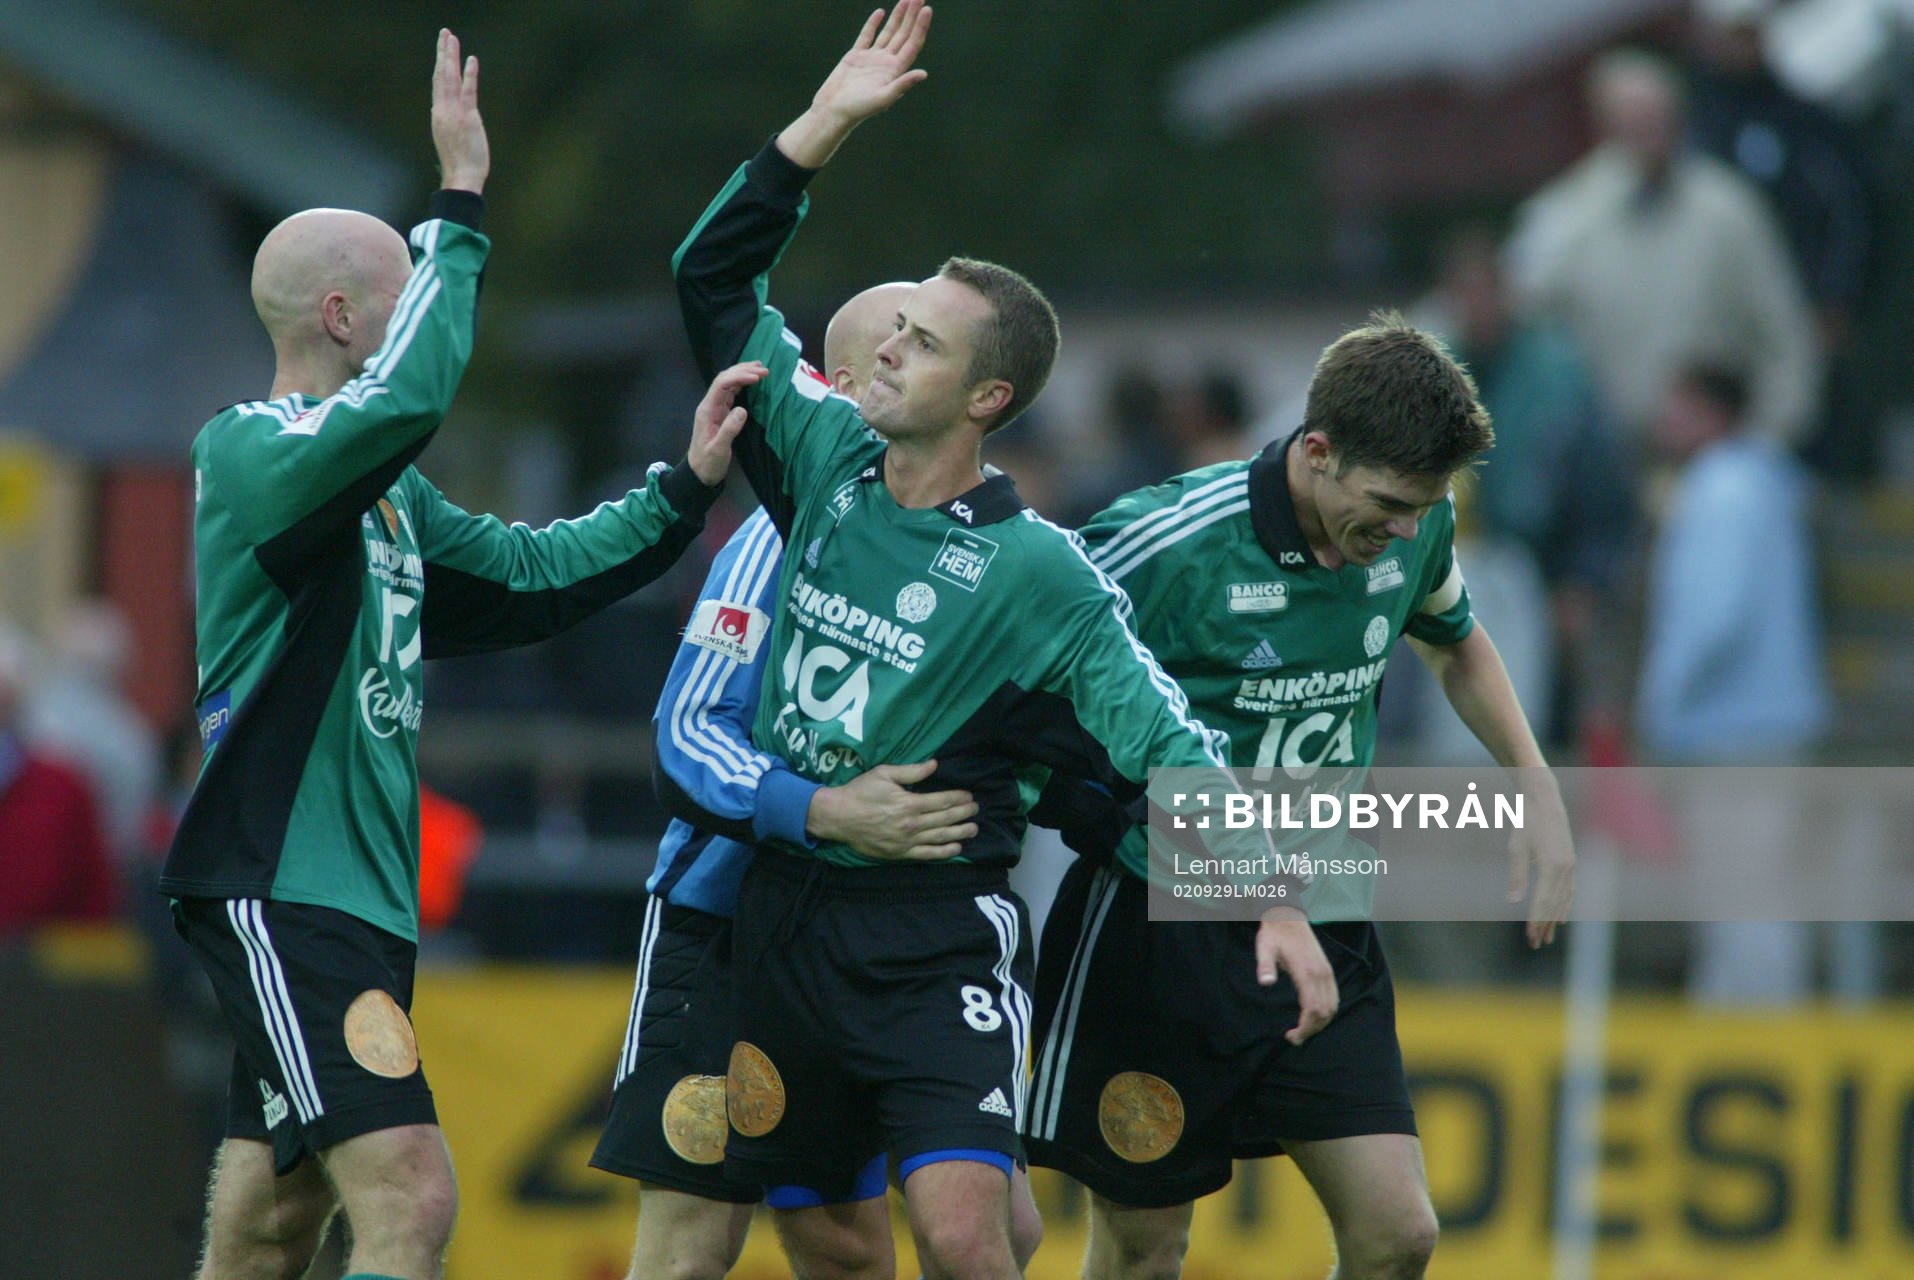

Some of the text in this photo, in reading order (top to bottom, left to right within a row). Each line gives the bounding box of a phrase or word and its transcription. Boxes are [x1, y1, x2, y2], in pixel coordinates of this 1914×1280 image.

[862, 466, 876, 477] CA
[950, 501, 973, 523] ICA
[937, 551, 982, 583] HEM
[947, 543, 985, 566] SVENSKA
[1280, 552, 1305, 564] ICA
[818, 622, 917, 674] närmaste stad
[783, 628, 869, 742] ICA
[1238, 658, 1387, 702] ENKÖPING
[1302, 690, 1362, 709] närmaste
[1252, 708, 1354, 782] ICA
[961, 985, 1002, 1032] 8
[979, 1102, 1012, 1118] adidas
[1402, 1068, 1914, 1246] DESI
